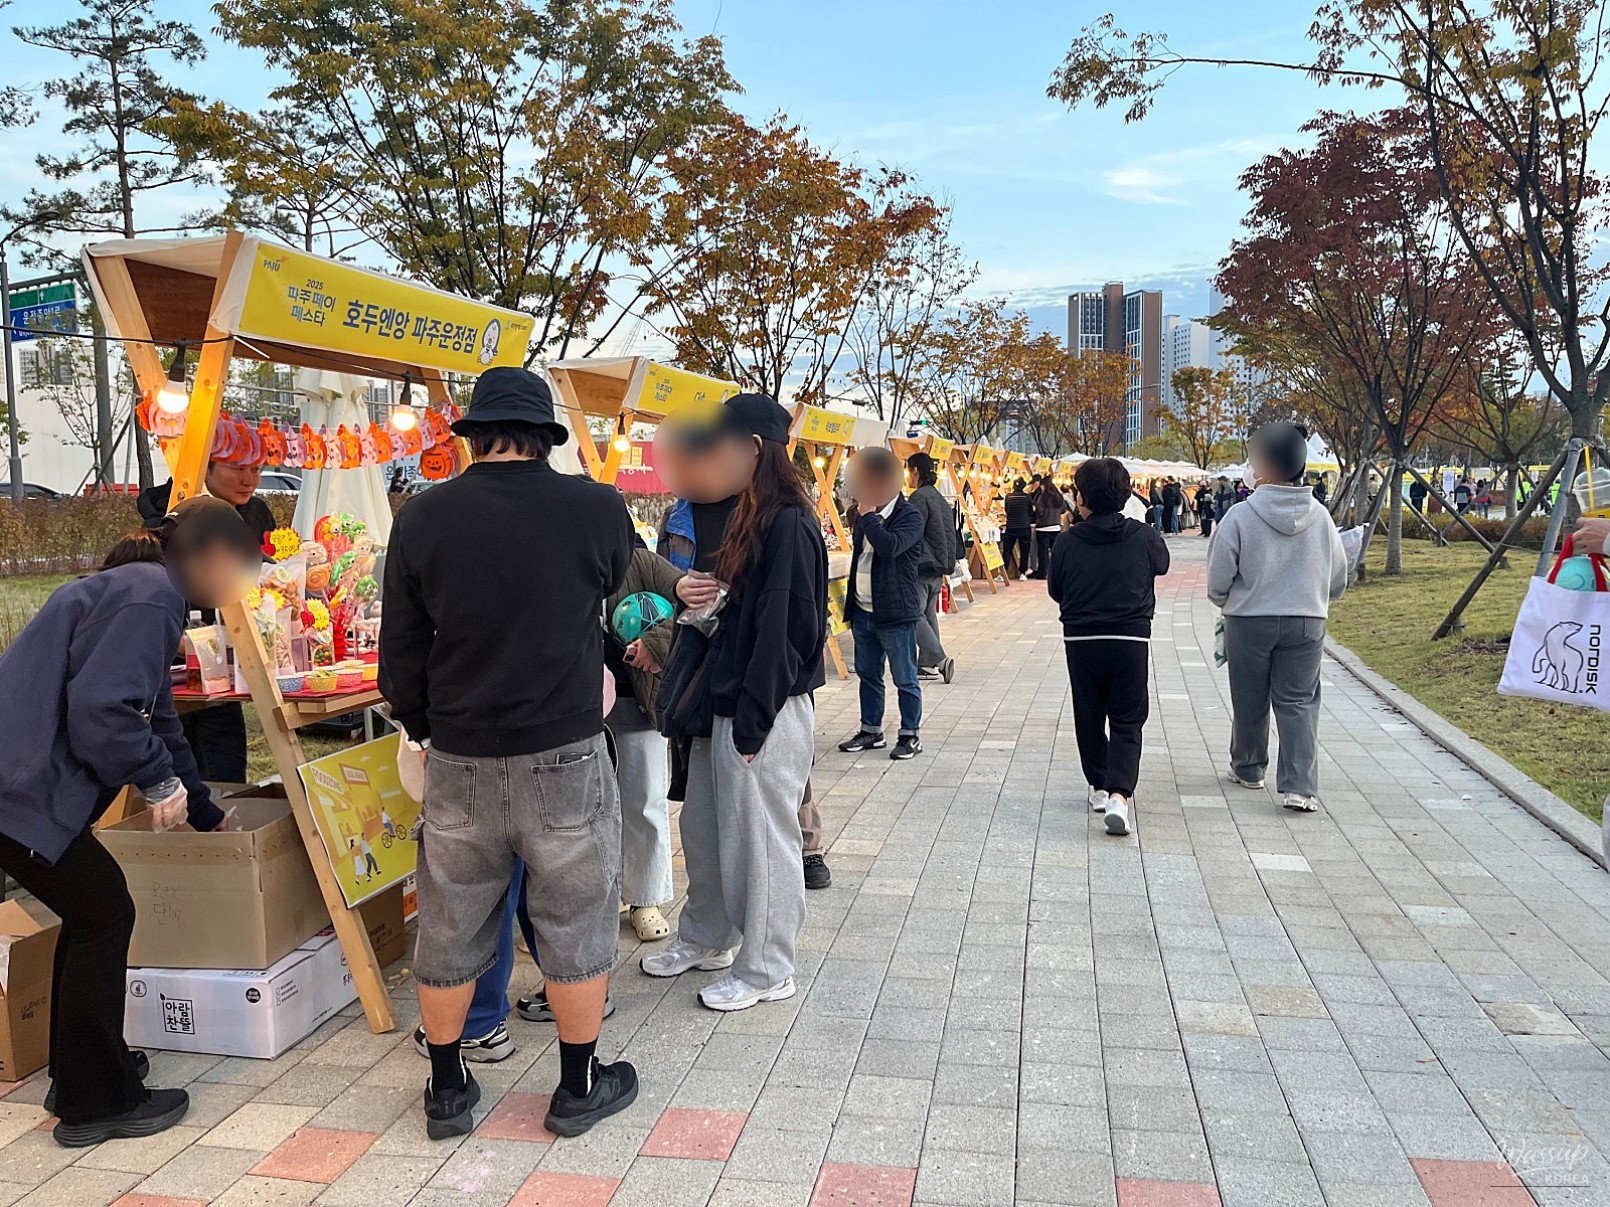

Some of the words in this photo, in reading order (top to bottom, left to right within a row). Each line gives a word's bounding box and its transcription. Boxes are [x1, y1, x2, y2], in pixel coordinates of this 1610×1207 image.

[306, 279, 324, 290] 2025
[291, 305, 325, 327] 페스타
[343, 299, 410, 340] 호두엔앙
[411, 316, 478, 354] 파주운정점
[165, 1001, 190, 1017] 아람
[167, 1015, 191, 1031] 찬뜰
